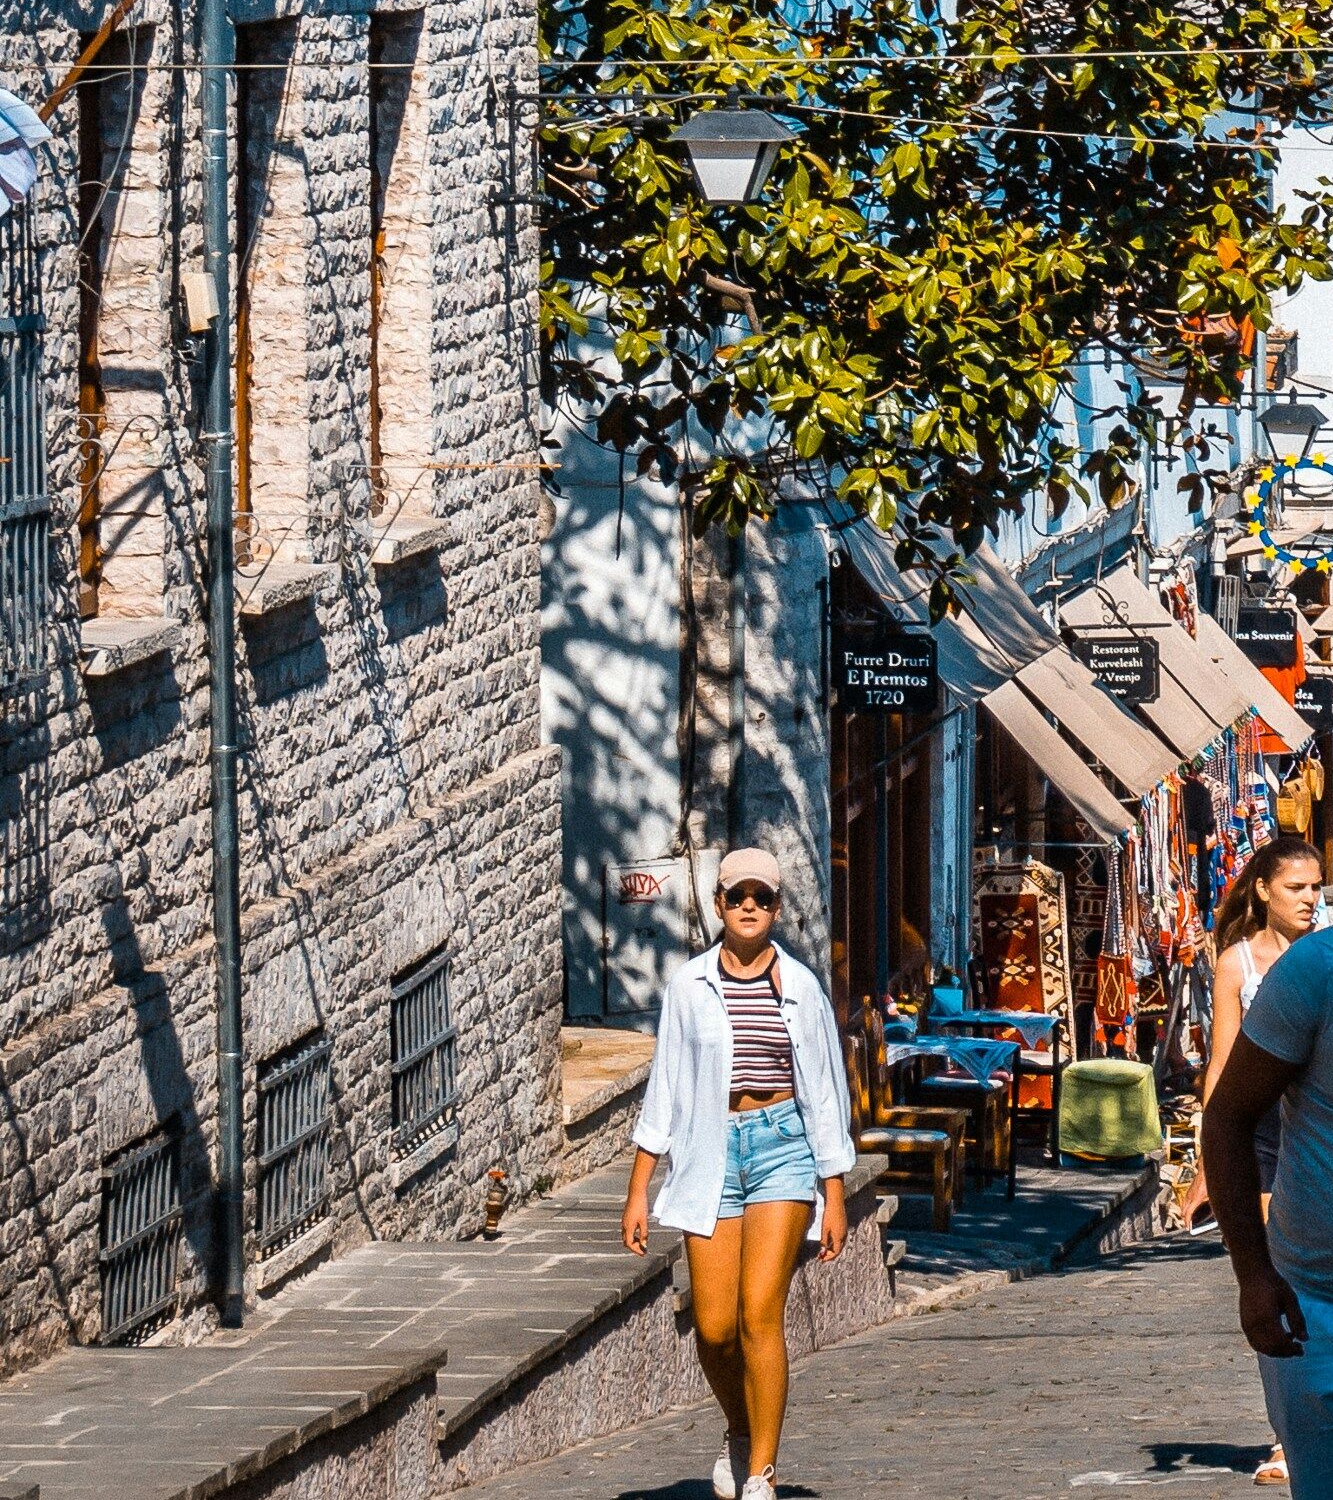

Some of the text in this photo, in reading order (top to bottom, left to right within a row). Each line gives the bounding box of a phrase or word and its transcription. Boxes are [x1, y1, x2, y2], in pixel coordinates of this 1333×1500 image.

[1251, 630, 1294, 641] Souvenir
[1092, 644, 1140, 655] Restorant
[843, 651, 930, 667] Furre Druri
[1089, 657, 1144, 669] Kurveleshi
[847, 669, 928, 687] E Premtos
[866, 690, 905, 705] 1720
